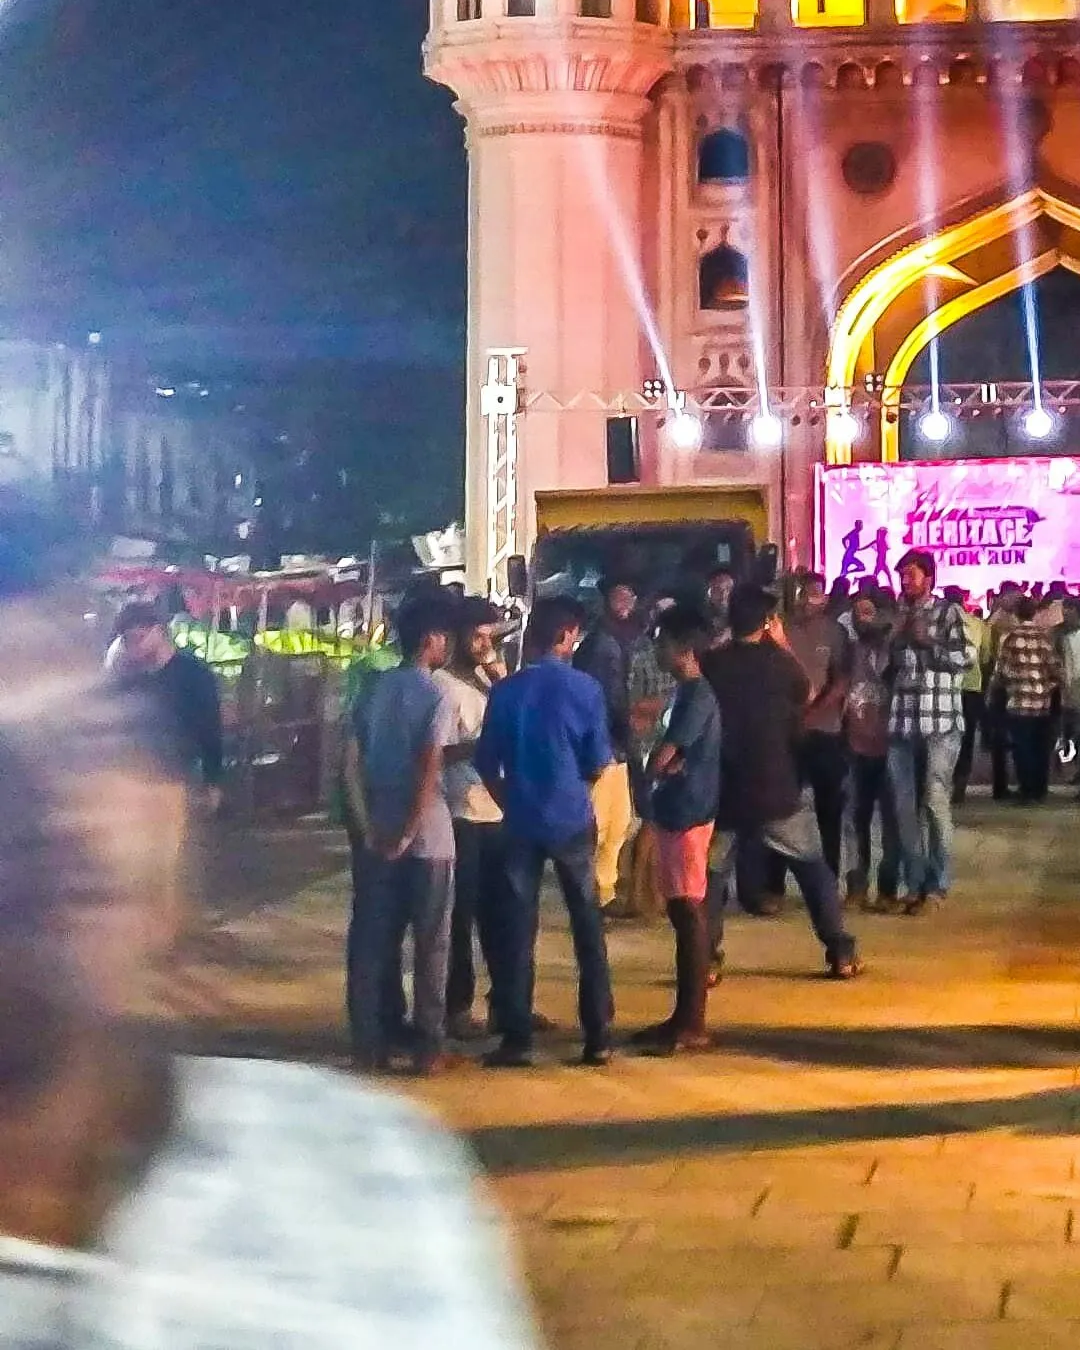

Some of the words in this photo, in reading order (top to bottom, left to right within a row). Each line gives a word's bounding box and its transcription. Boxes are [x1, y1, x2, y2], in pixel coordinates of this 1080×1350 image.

[911, 517, 1033, 547] HERITAGE
[948, 549, 981, 567] 10K
[987, 549, 1026, 566] RUN
